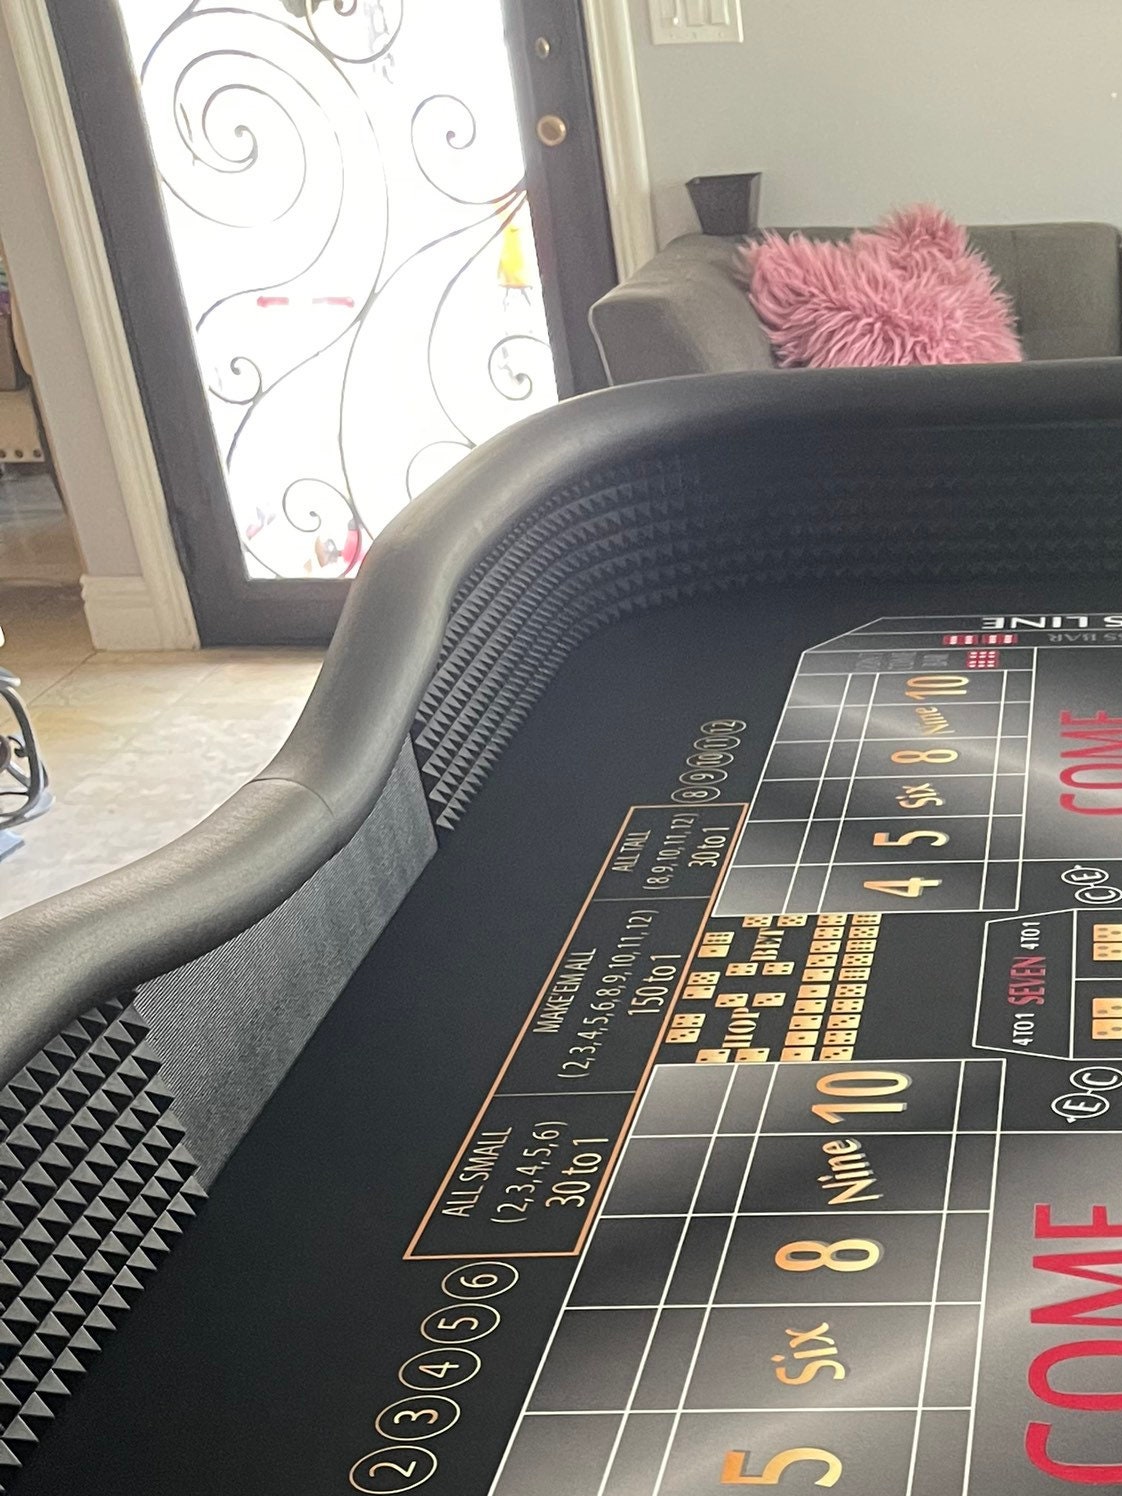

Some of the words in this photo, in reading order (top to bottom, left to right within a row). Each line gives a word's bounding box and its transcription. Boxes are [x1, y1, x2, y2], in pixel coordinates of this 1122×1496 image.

[981, 616, 1088, 630] LINE
[904, 675, 970, 700] 10
[890, 748, 959, 764] 8
[895, 782, 945, 809] Six
[873, 830, 950, 847] 5
[863, 877, 943, 898] 4
[564, 948, 597, 971] ALL
[1008, 955, 1047, 1005] SEVEN
[627, 986, 669, 1016] 150
[722, 1007, 760, 1048] HOP
[811, 1070, 912, 1124] 10
[459, 1126, 513, 1181] SMALL
[561, 1153, 602, 1175] to
[817, 1138, 884, 1205] Nine
[441, 1184, 484, 1217] ALL
[545, 1180, 591, 1208] 30
[774, 1238, 884, 1272] 8
[459, 1273, 498, 1288] 6
[437, 1317, 479, 1330] 5
[770, 1322, 847, 1386] Six
[418, 1361, 460, 1379] 4
[393, 1408, 439, 1424] 3
[369, 1460, 417, 1478] 2
[720, 1447, 844, 1488] 5
